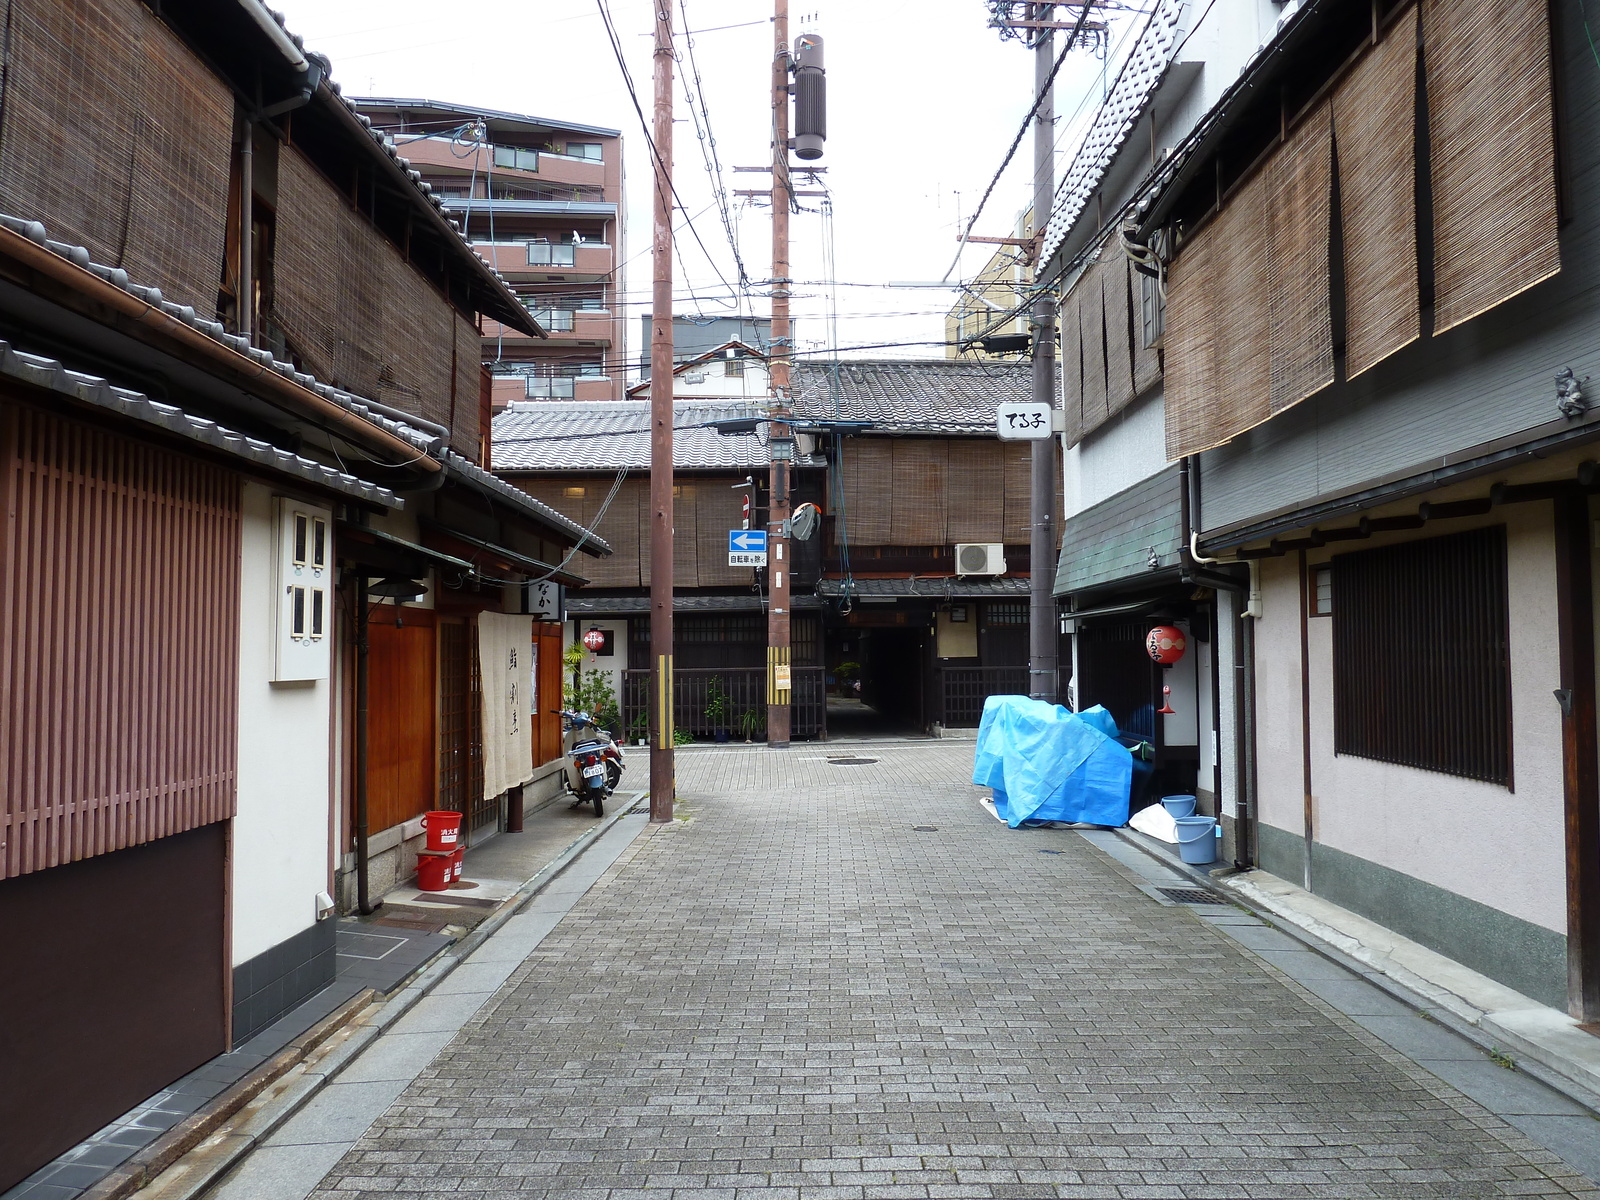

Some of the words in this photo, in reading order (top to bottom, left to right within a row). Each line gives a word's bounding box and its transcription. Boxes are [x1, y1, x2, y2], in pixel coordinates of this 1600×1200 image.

[1005, 413, 1046, 429] てる子
[731, 555, 765, 564] 自転車を除く
